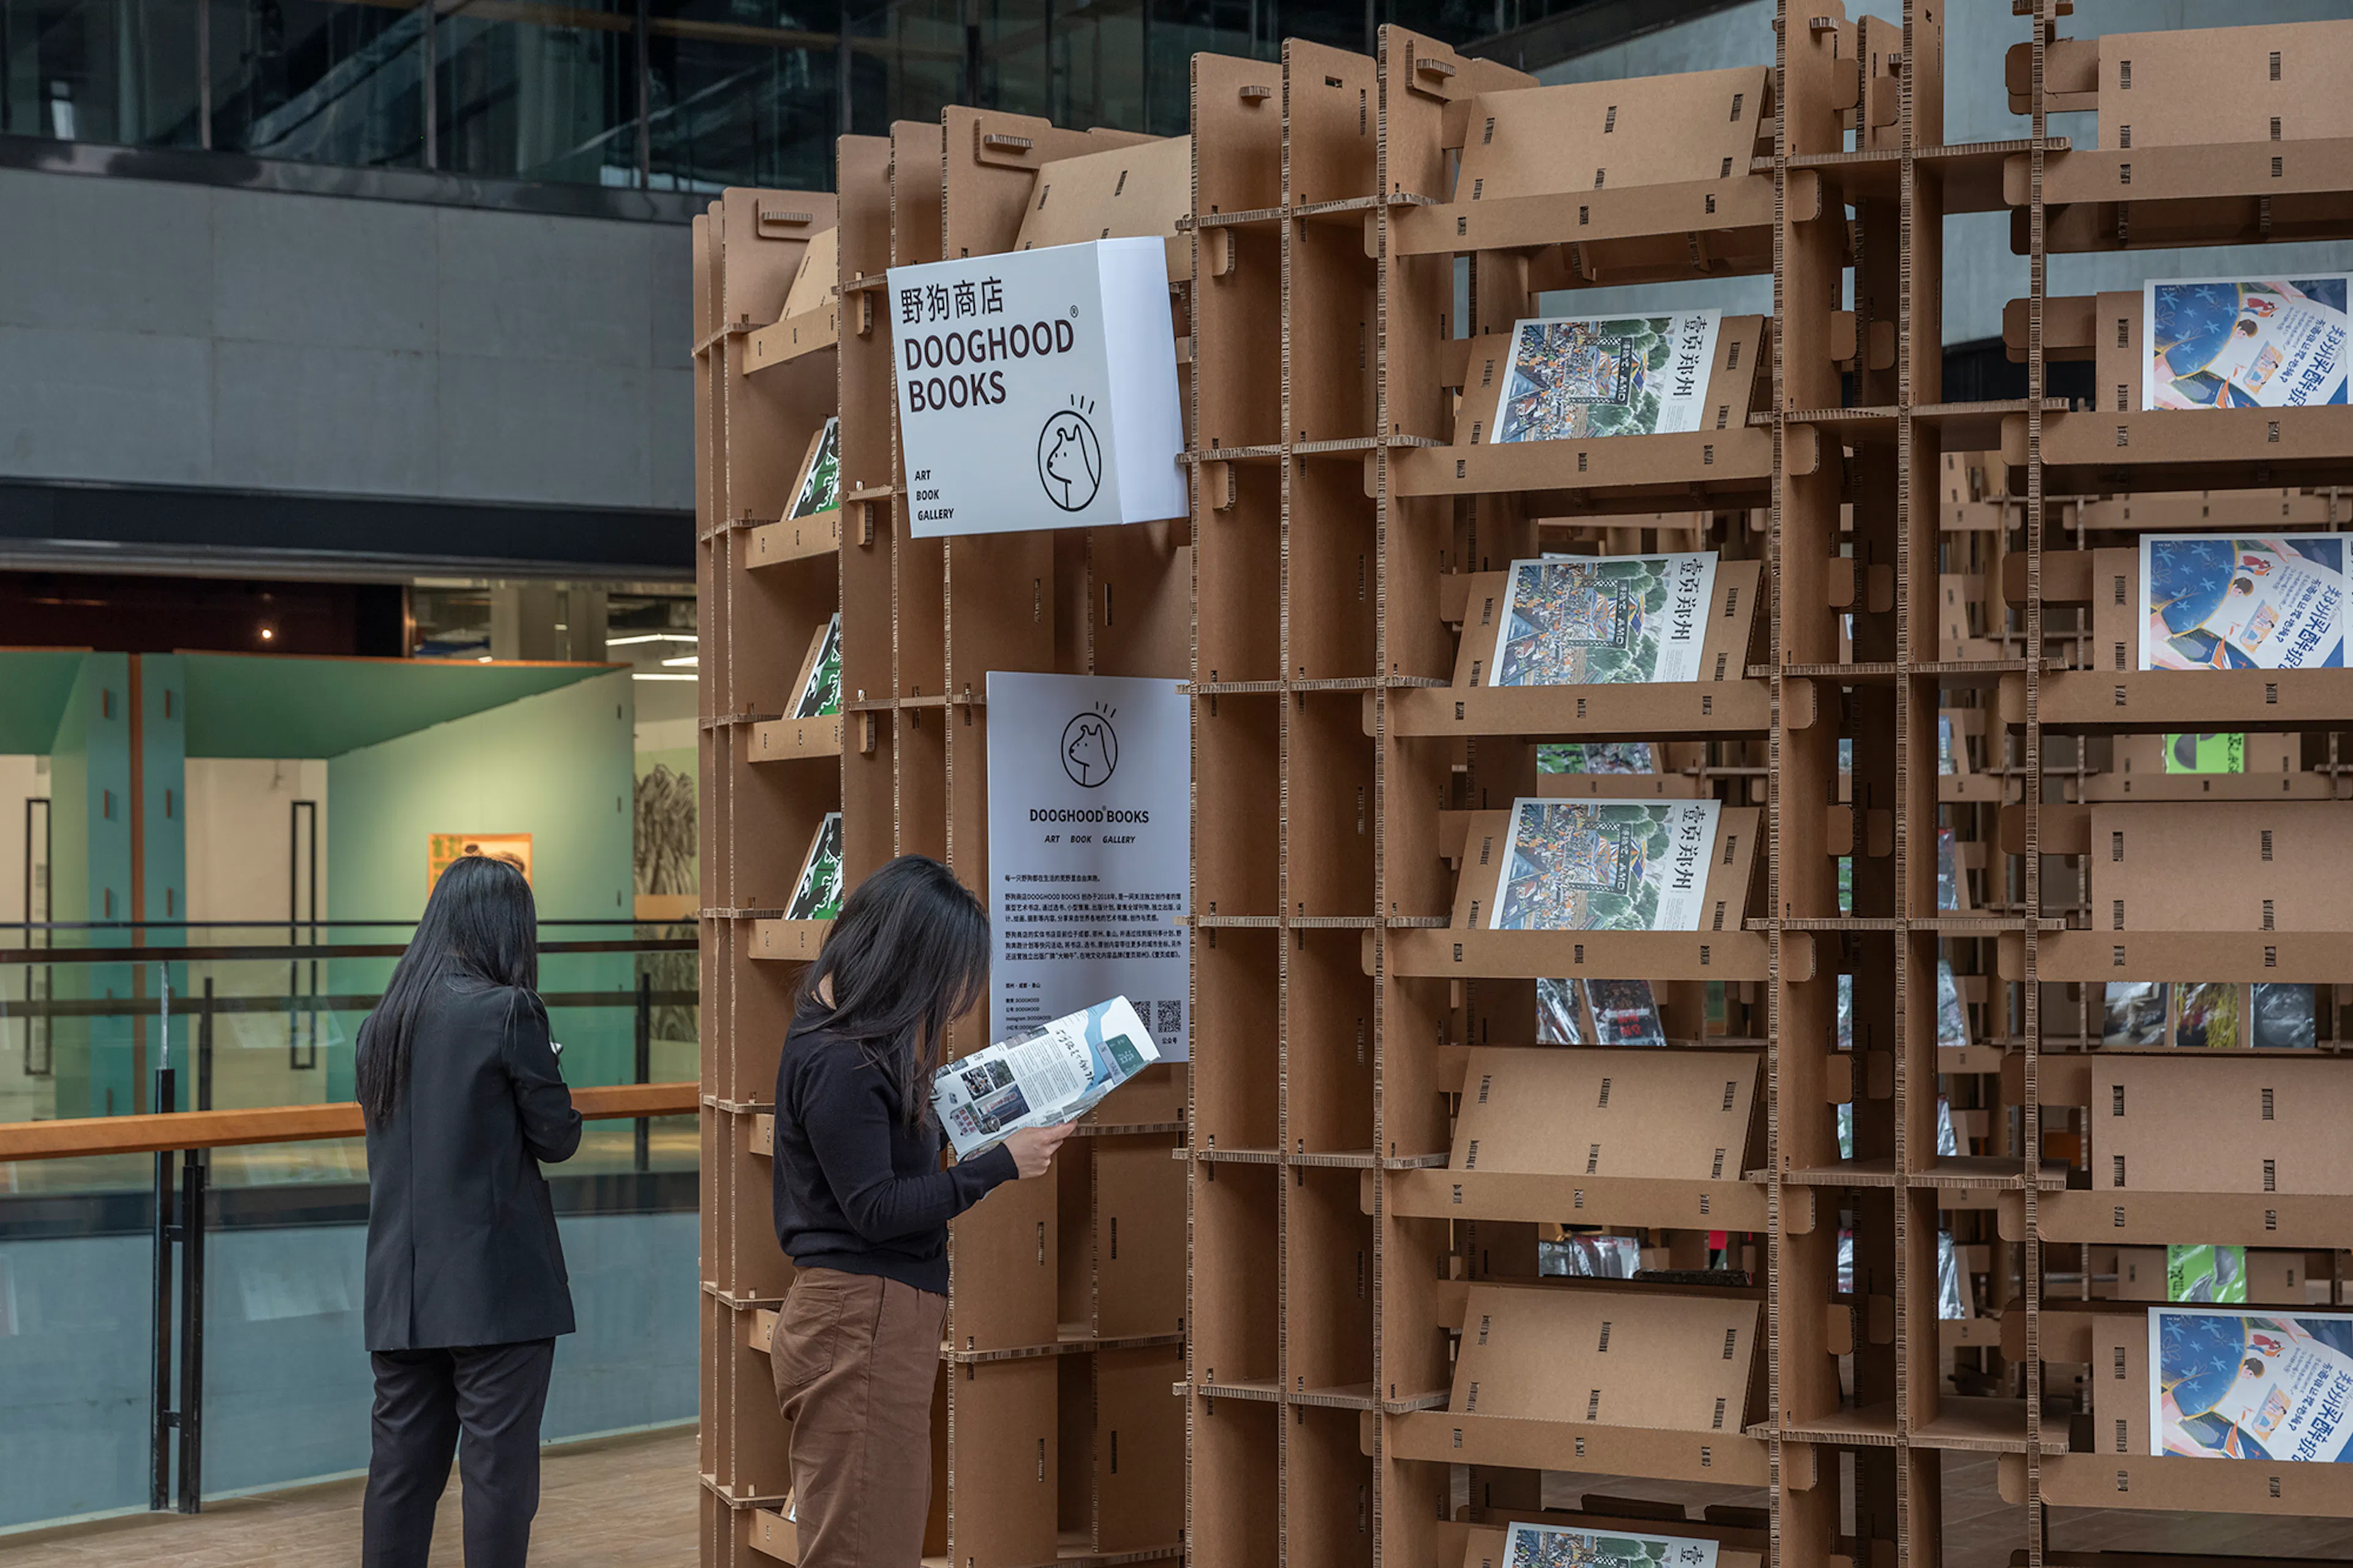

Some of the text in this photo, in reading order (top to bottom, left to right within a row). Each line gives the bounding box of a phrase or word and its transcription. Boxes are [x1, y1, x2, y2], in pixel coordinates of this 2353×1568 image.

[900, 276, 1004, 325] 野狗商店
[904, 319, 1075, 371] DOOGHOOD
[1673, 313, 1708, 397] 壹页郑州
[2282, 324, 2347, 407] 郑州买醉报
[907, 370, 1007, 413] BOOKS
[914, 469, 931, 482] ART
[915, 489, 940, 501] BOOK
[917, 507, 955, 521] GALLERY
[1670, 558, 1704, 643] 壹页郑州
[2278, 584, 2343, 669] 郑州买醉报
[1029, 809, 1150, 824] DOOGHOOD BOOKS
[1102, 835, 1136, 844] GALLERY
[1672, 804, 1707, 890] 壹页郑州
